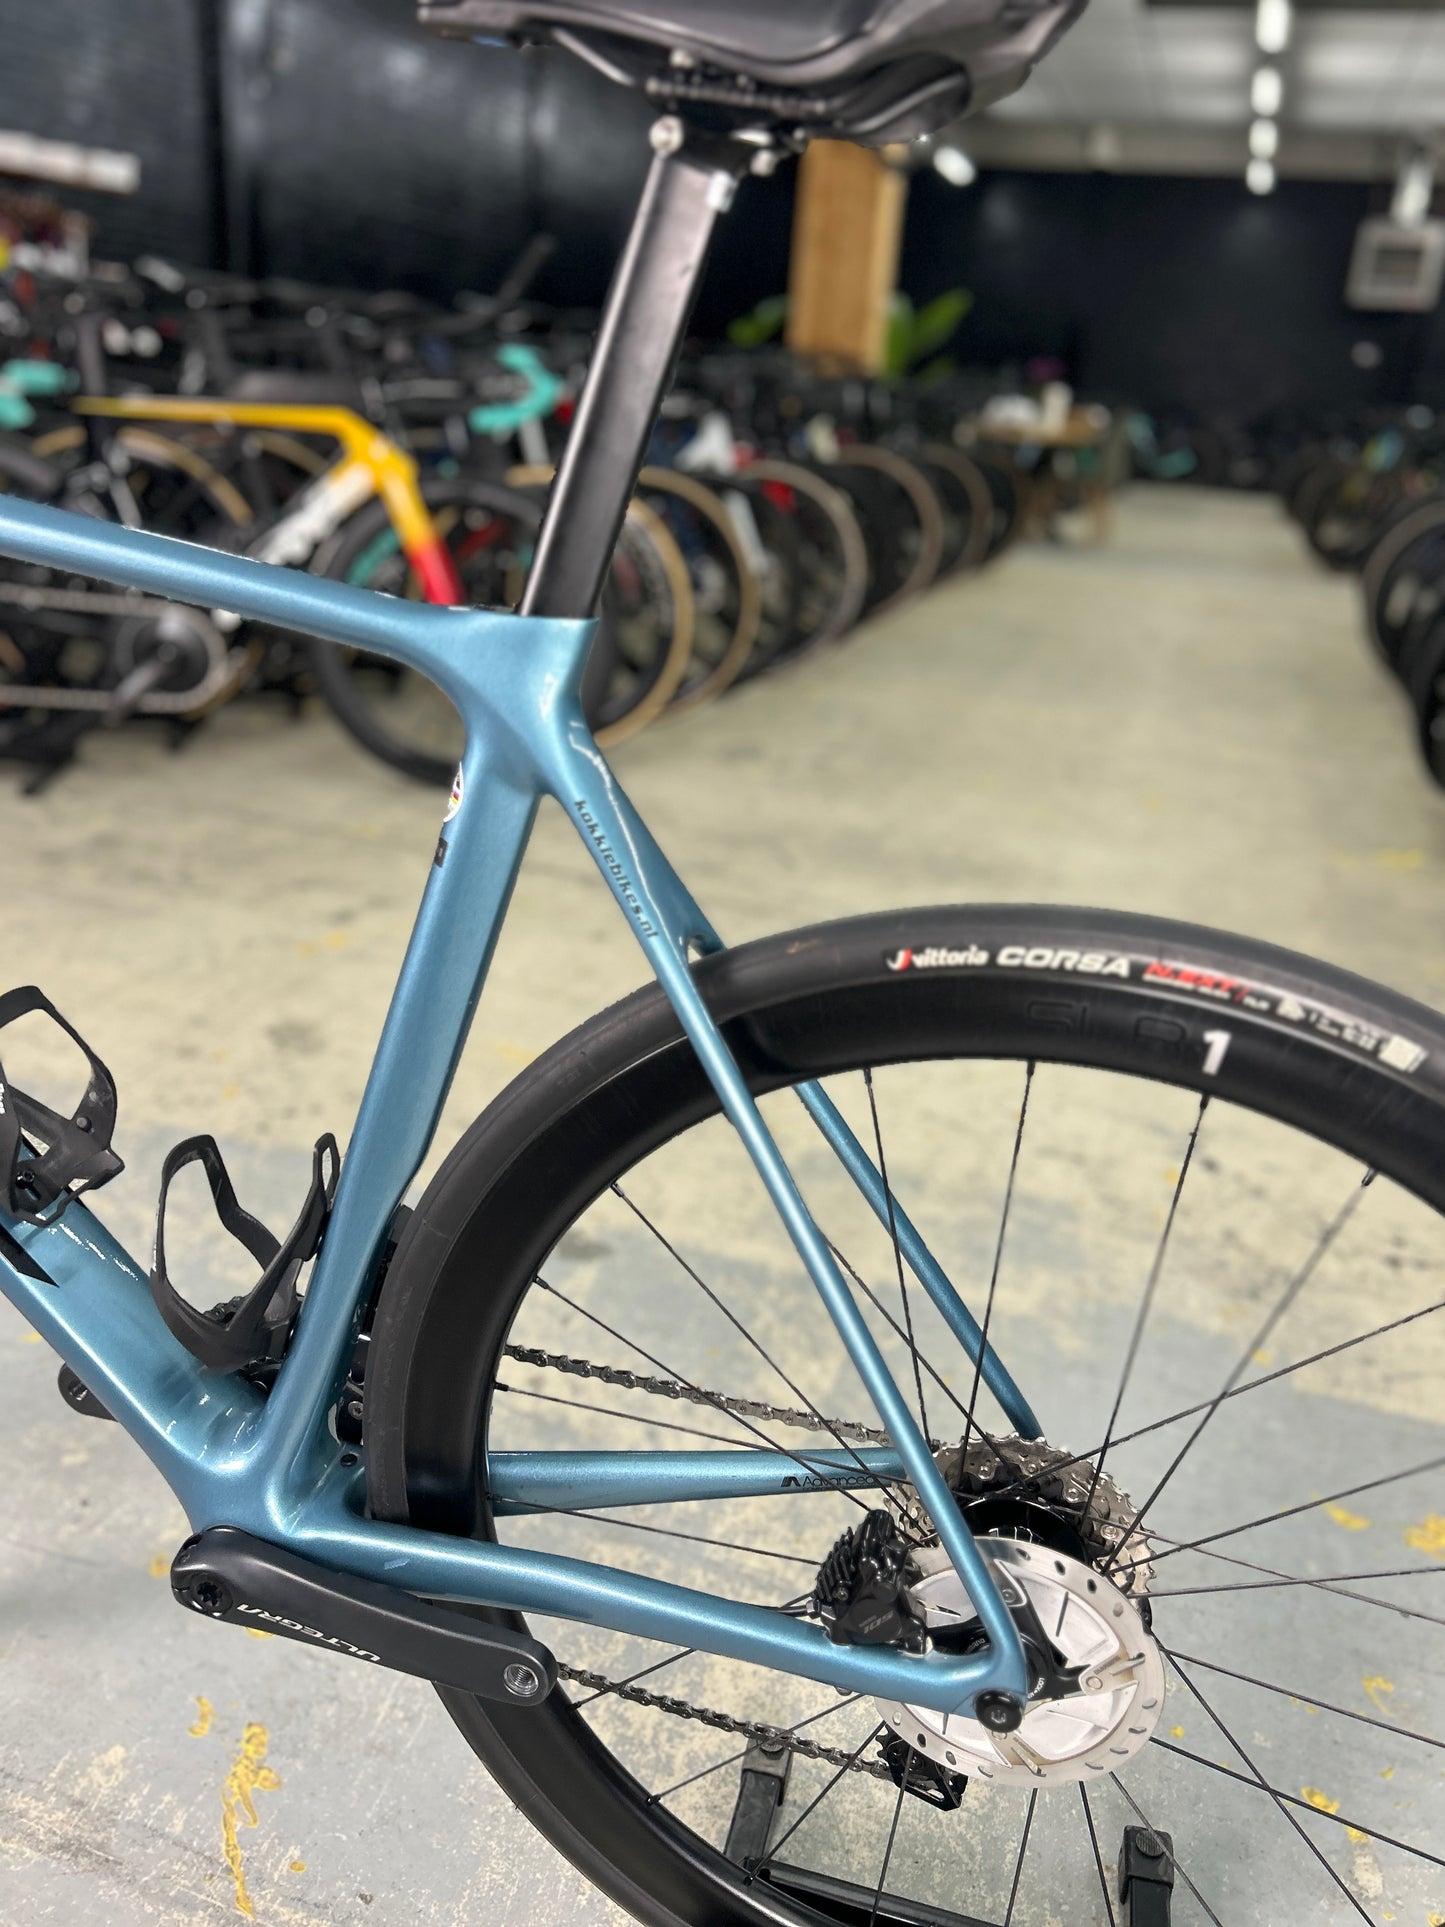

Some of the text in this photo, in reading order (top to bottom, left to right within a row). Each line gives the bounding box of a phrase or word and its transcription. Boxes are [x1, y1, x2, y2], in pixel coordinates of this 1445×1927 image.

[574, 799, 659, 938] kokkiebikes.nl
[911, 945, 989, 969] vittoria
[996, 946, 1130, 978] CORSA
[1202, 1029, 1232, 1076] 1
[237, 1604, 381, 1662] ULTEGRA
